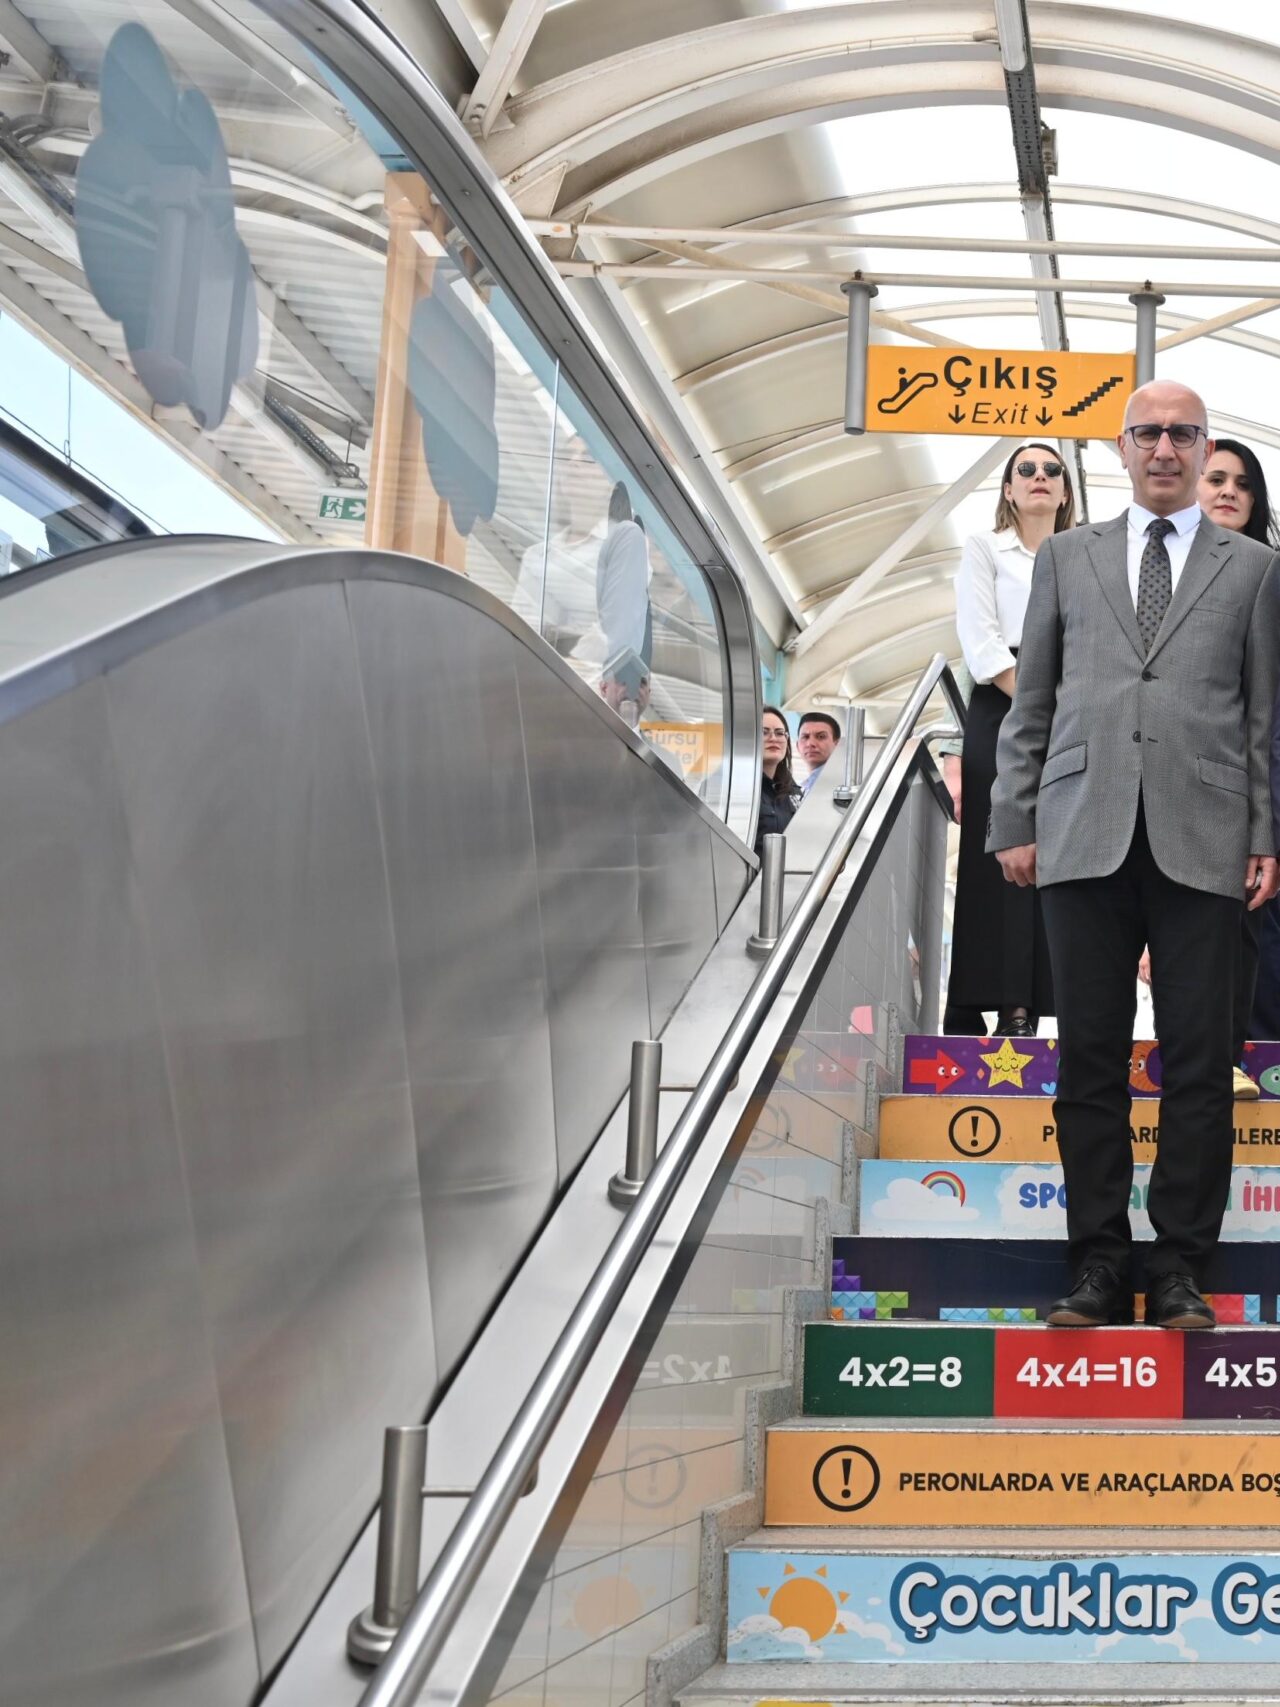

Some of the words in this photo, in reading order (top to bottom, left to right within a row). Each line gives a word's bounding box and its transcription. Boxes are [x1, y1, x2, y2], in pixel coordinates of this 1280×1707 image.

[943, 355, 1058, 399] Çıkış
[971, 402, 1029, 425] Exit
[838, 1356, 963, 1388] 4x2=8
[1016, 1356, 1158, 1388] 4x4=16
[899, 1472, 1054, 1492] PERONLARDA
[1060, 1472, 1090, 1492] VE
[1096, 1472, 1235, 1497] ARAÇLARDA
[897, 1571, 1190, 1640] Çocuklar
